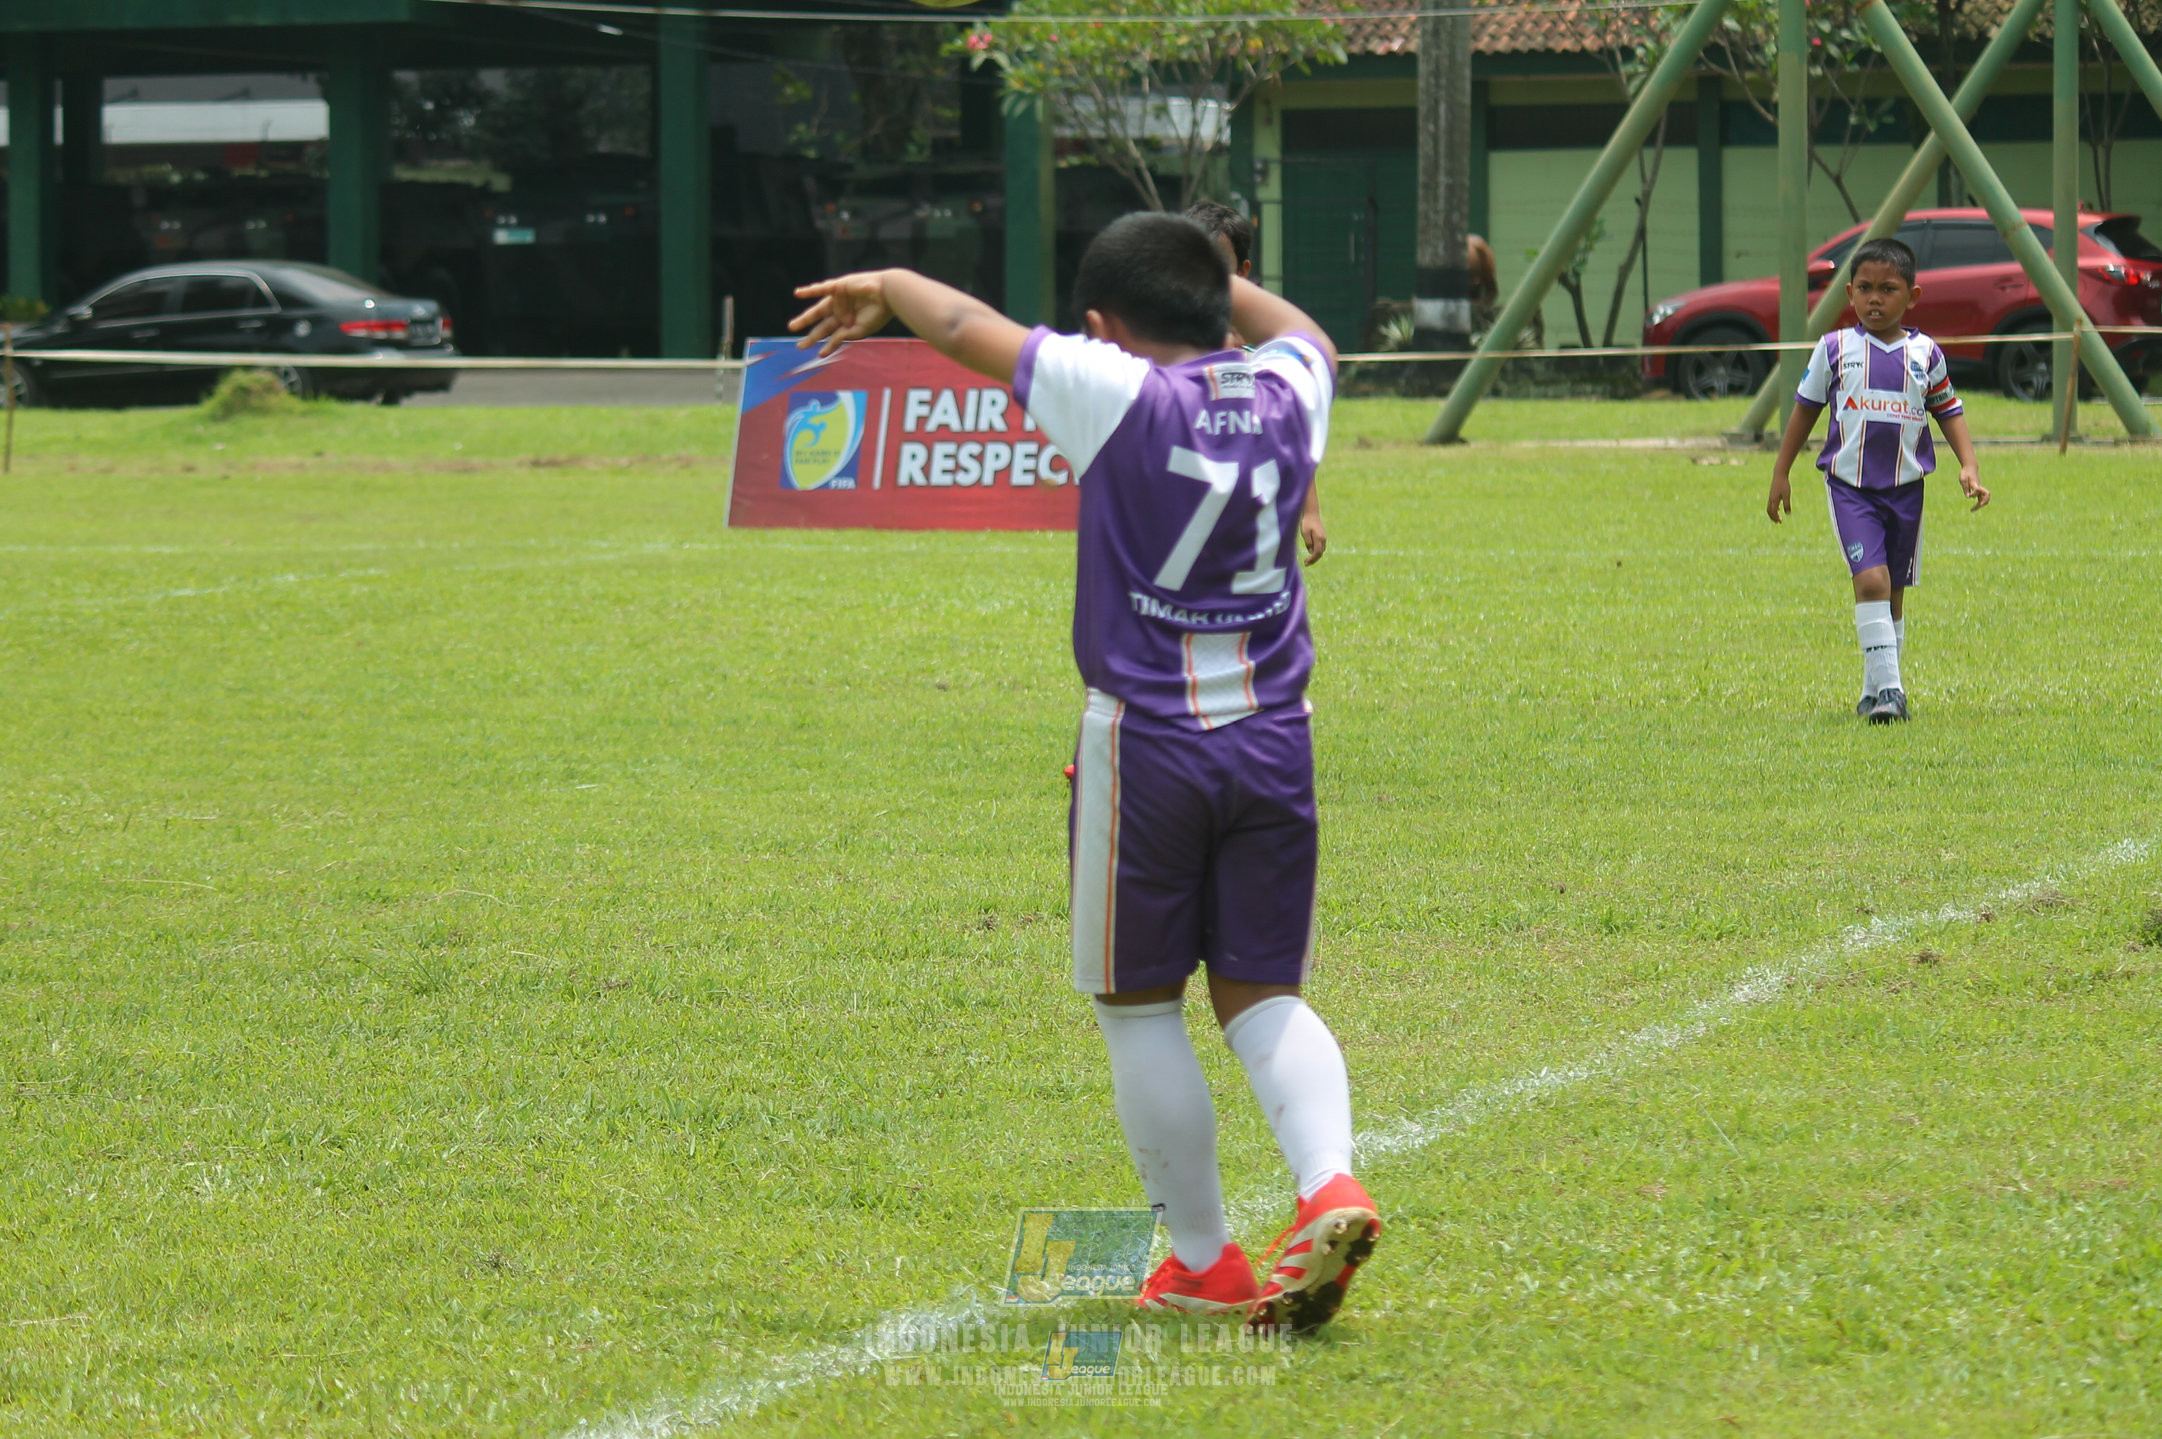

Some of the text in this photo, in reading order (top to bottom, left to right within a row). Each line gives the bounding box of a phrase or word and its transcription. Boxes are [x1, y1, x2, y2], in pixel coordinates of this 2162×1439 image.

[904, 388, 1008, 433] FAIR
[830, 478, 855, 489] FIFA
[897, 441, 1081, 487] RESPEC
[1153, 445, 1288, 594] 71
